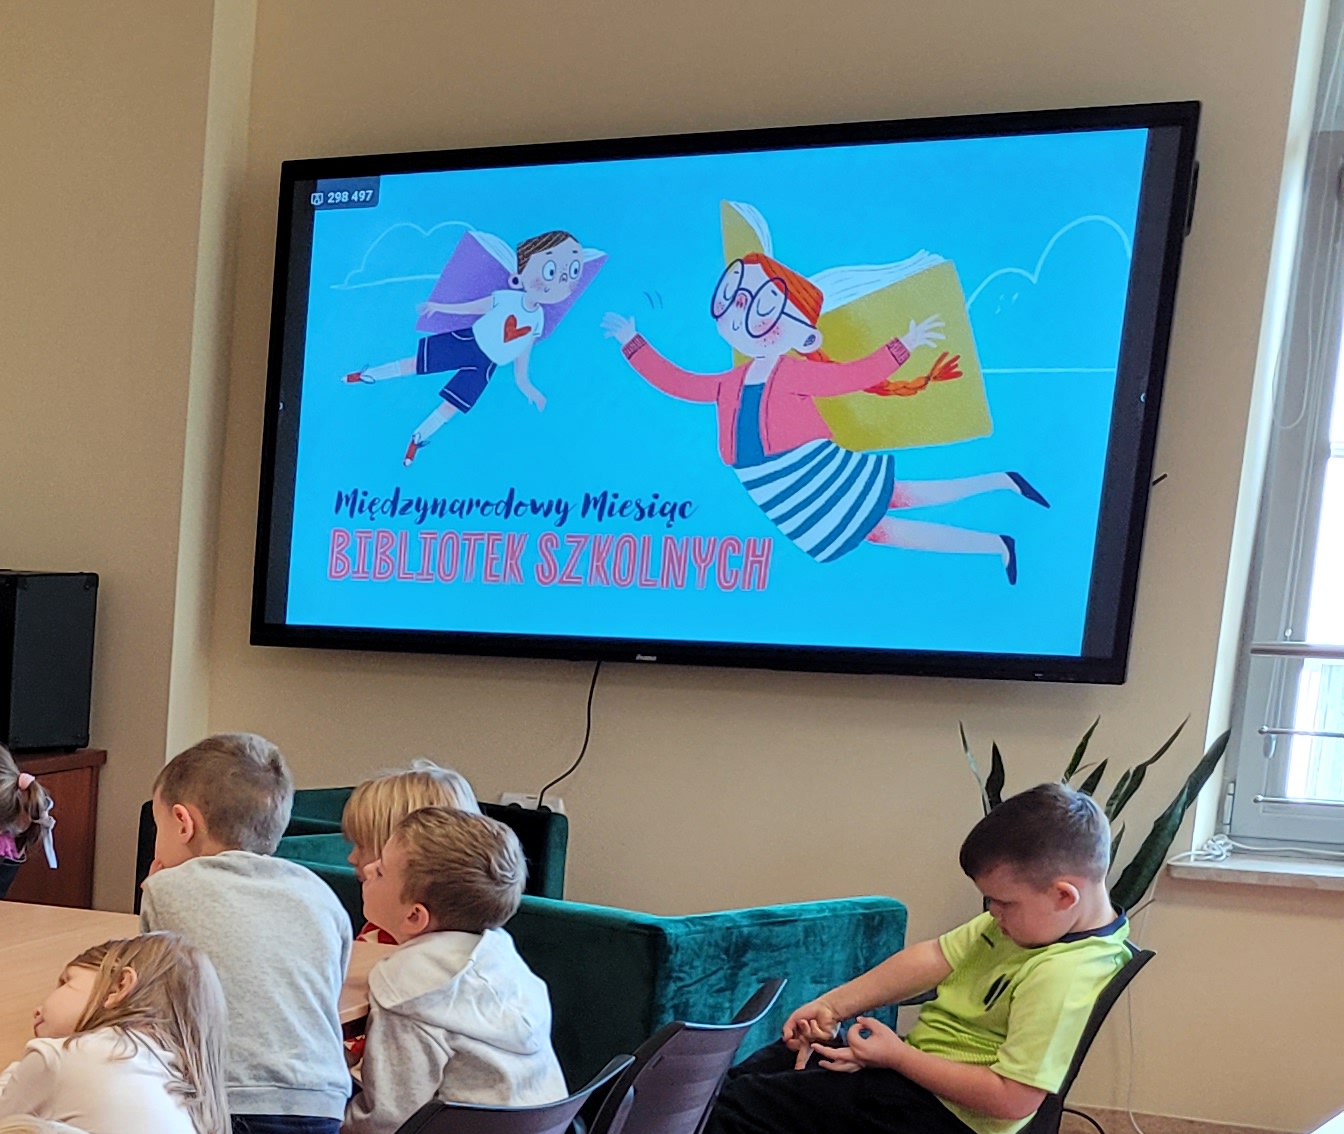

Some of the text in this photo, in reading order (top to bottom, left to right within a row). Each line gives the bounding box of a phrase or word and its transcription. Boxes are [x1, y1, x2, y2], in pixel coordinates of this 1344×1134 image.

[327, 189, 373, 204] 298 497
[334, 486, 698, 528] Międzynarodowy Miesiąc
[327, 528, 773, 592] BIBLIOTEK SZKOLNYCH
